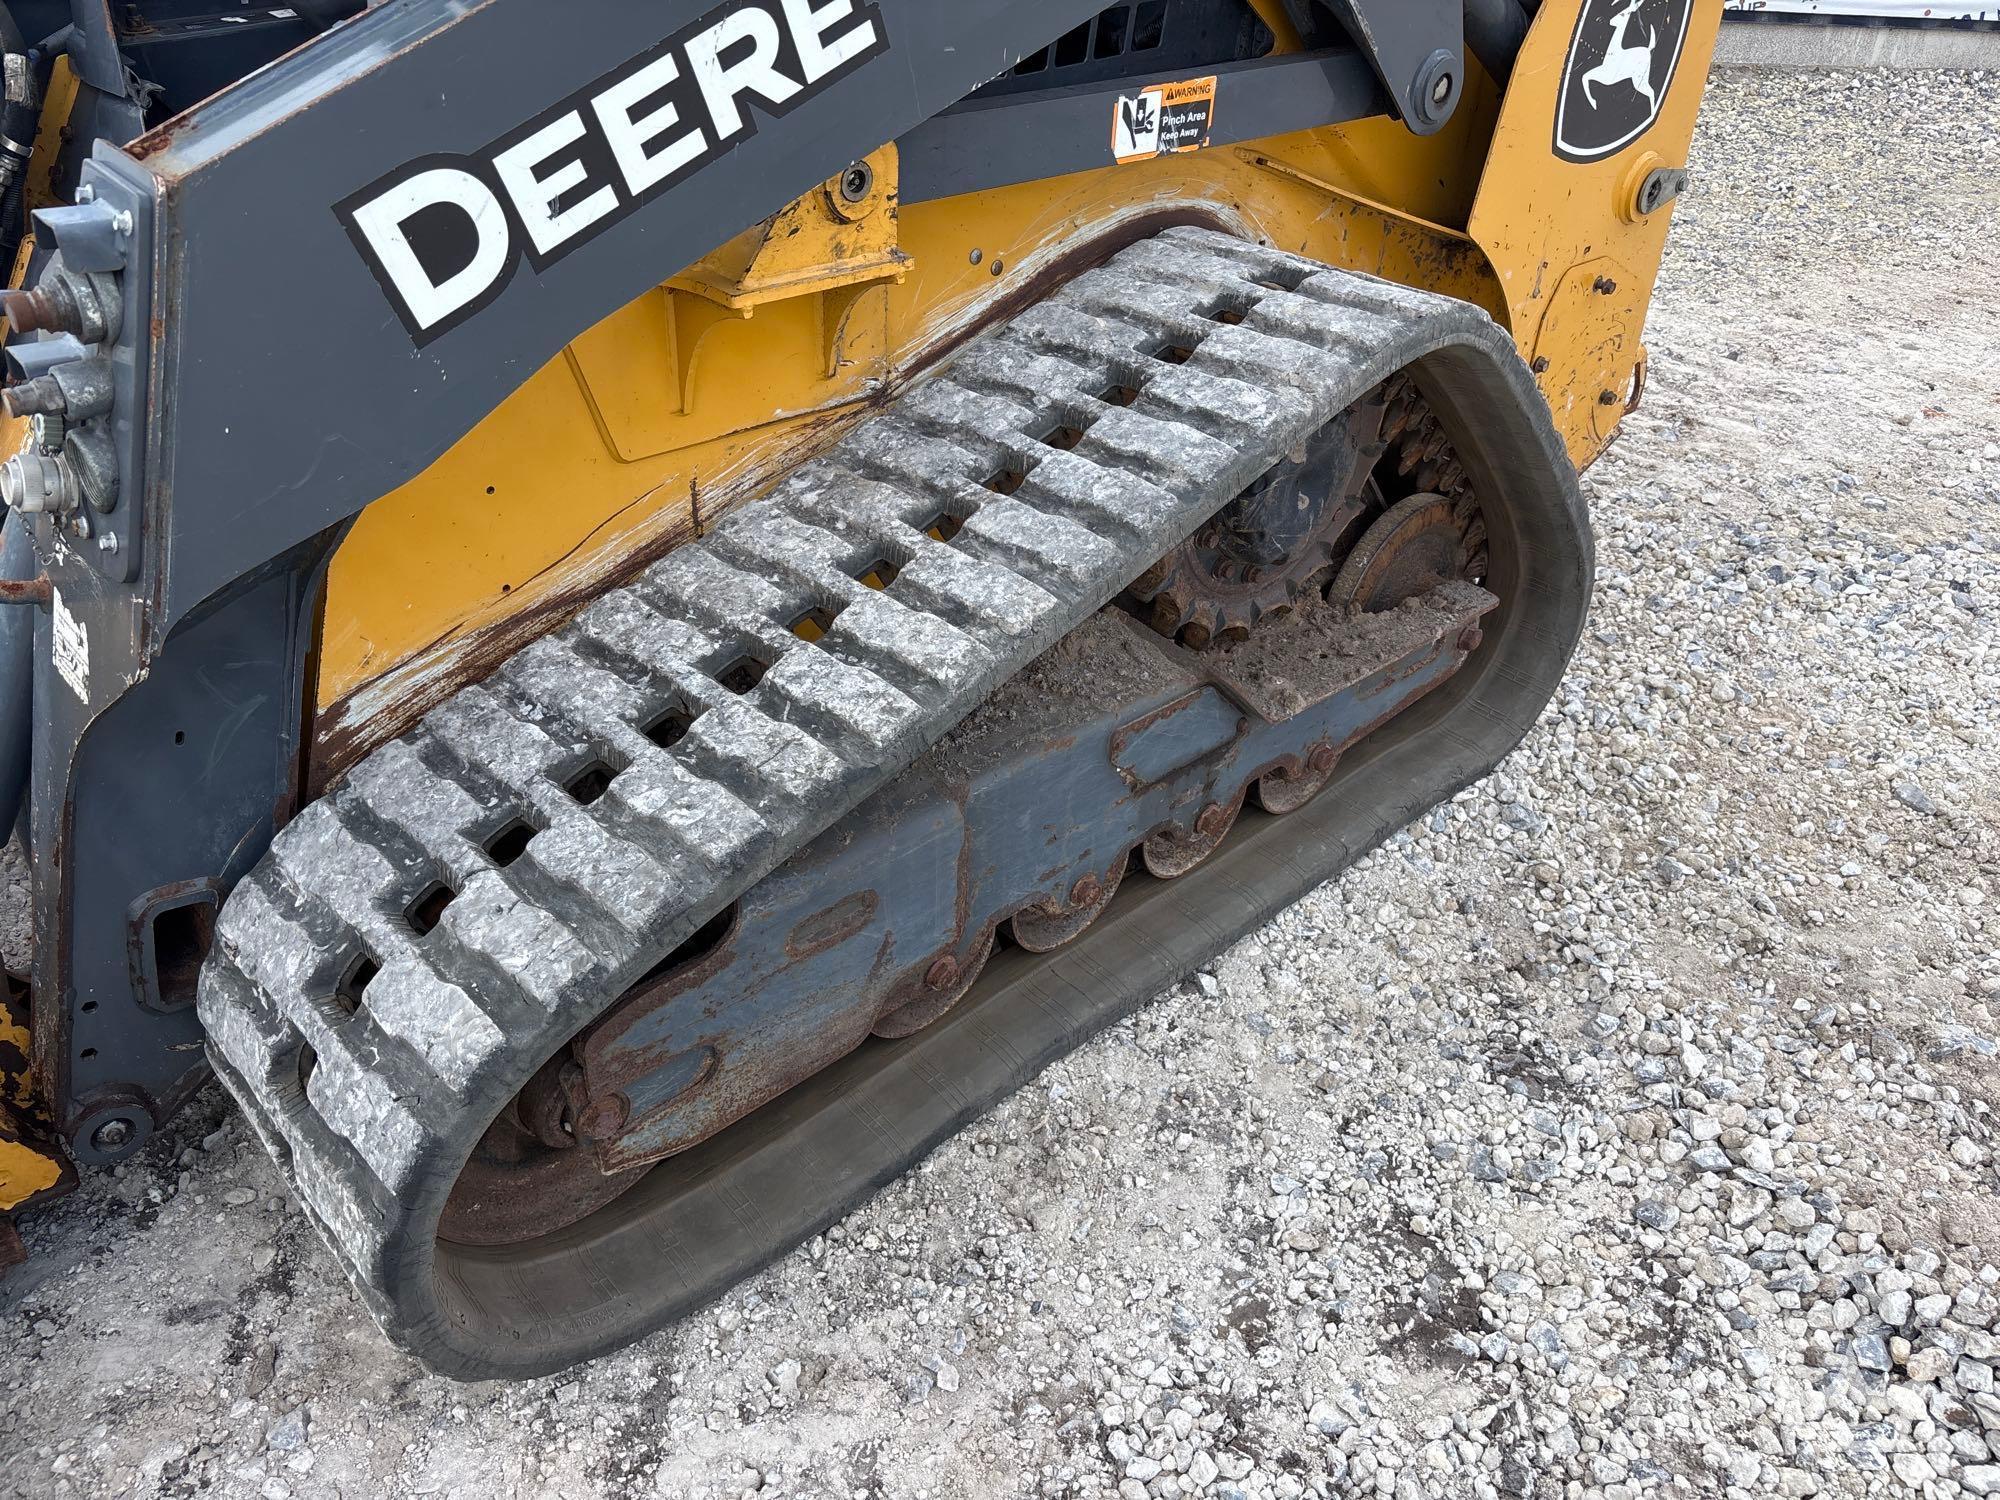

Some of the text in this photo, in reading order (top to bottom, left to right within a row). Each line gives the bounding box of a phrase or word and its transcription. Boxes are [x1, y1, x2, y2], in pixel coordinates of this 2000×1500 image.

[1174, 84, 1211, 99] WARNING
[1162, 111, 1206, 126] Pinch Area
[1161, 127, 1199, 141] Keep Away
[353, 0, 877, 330] DEERE
